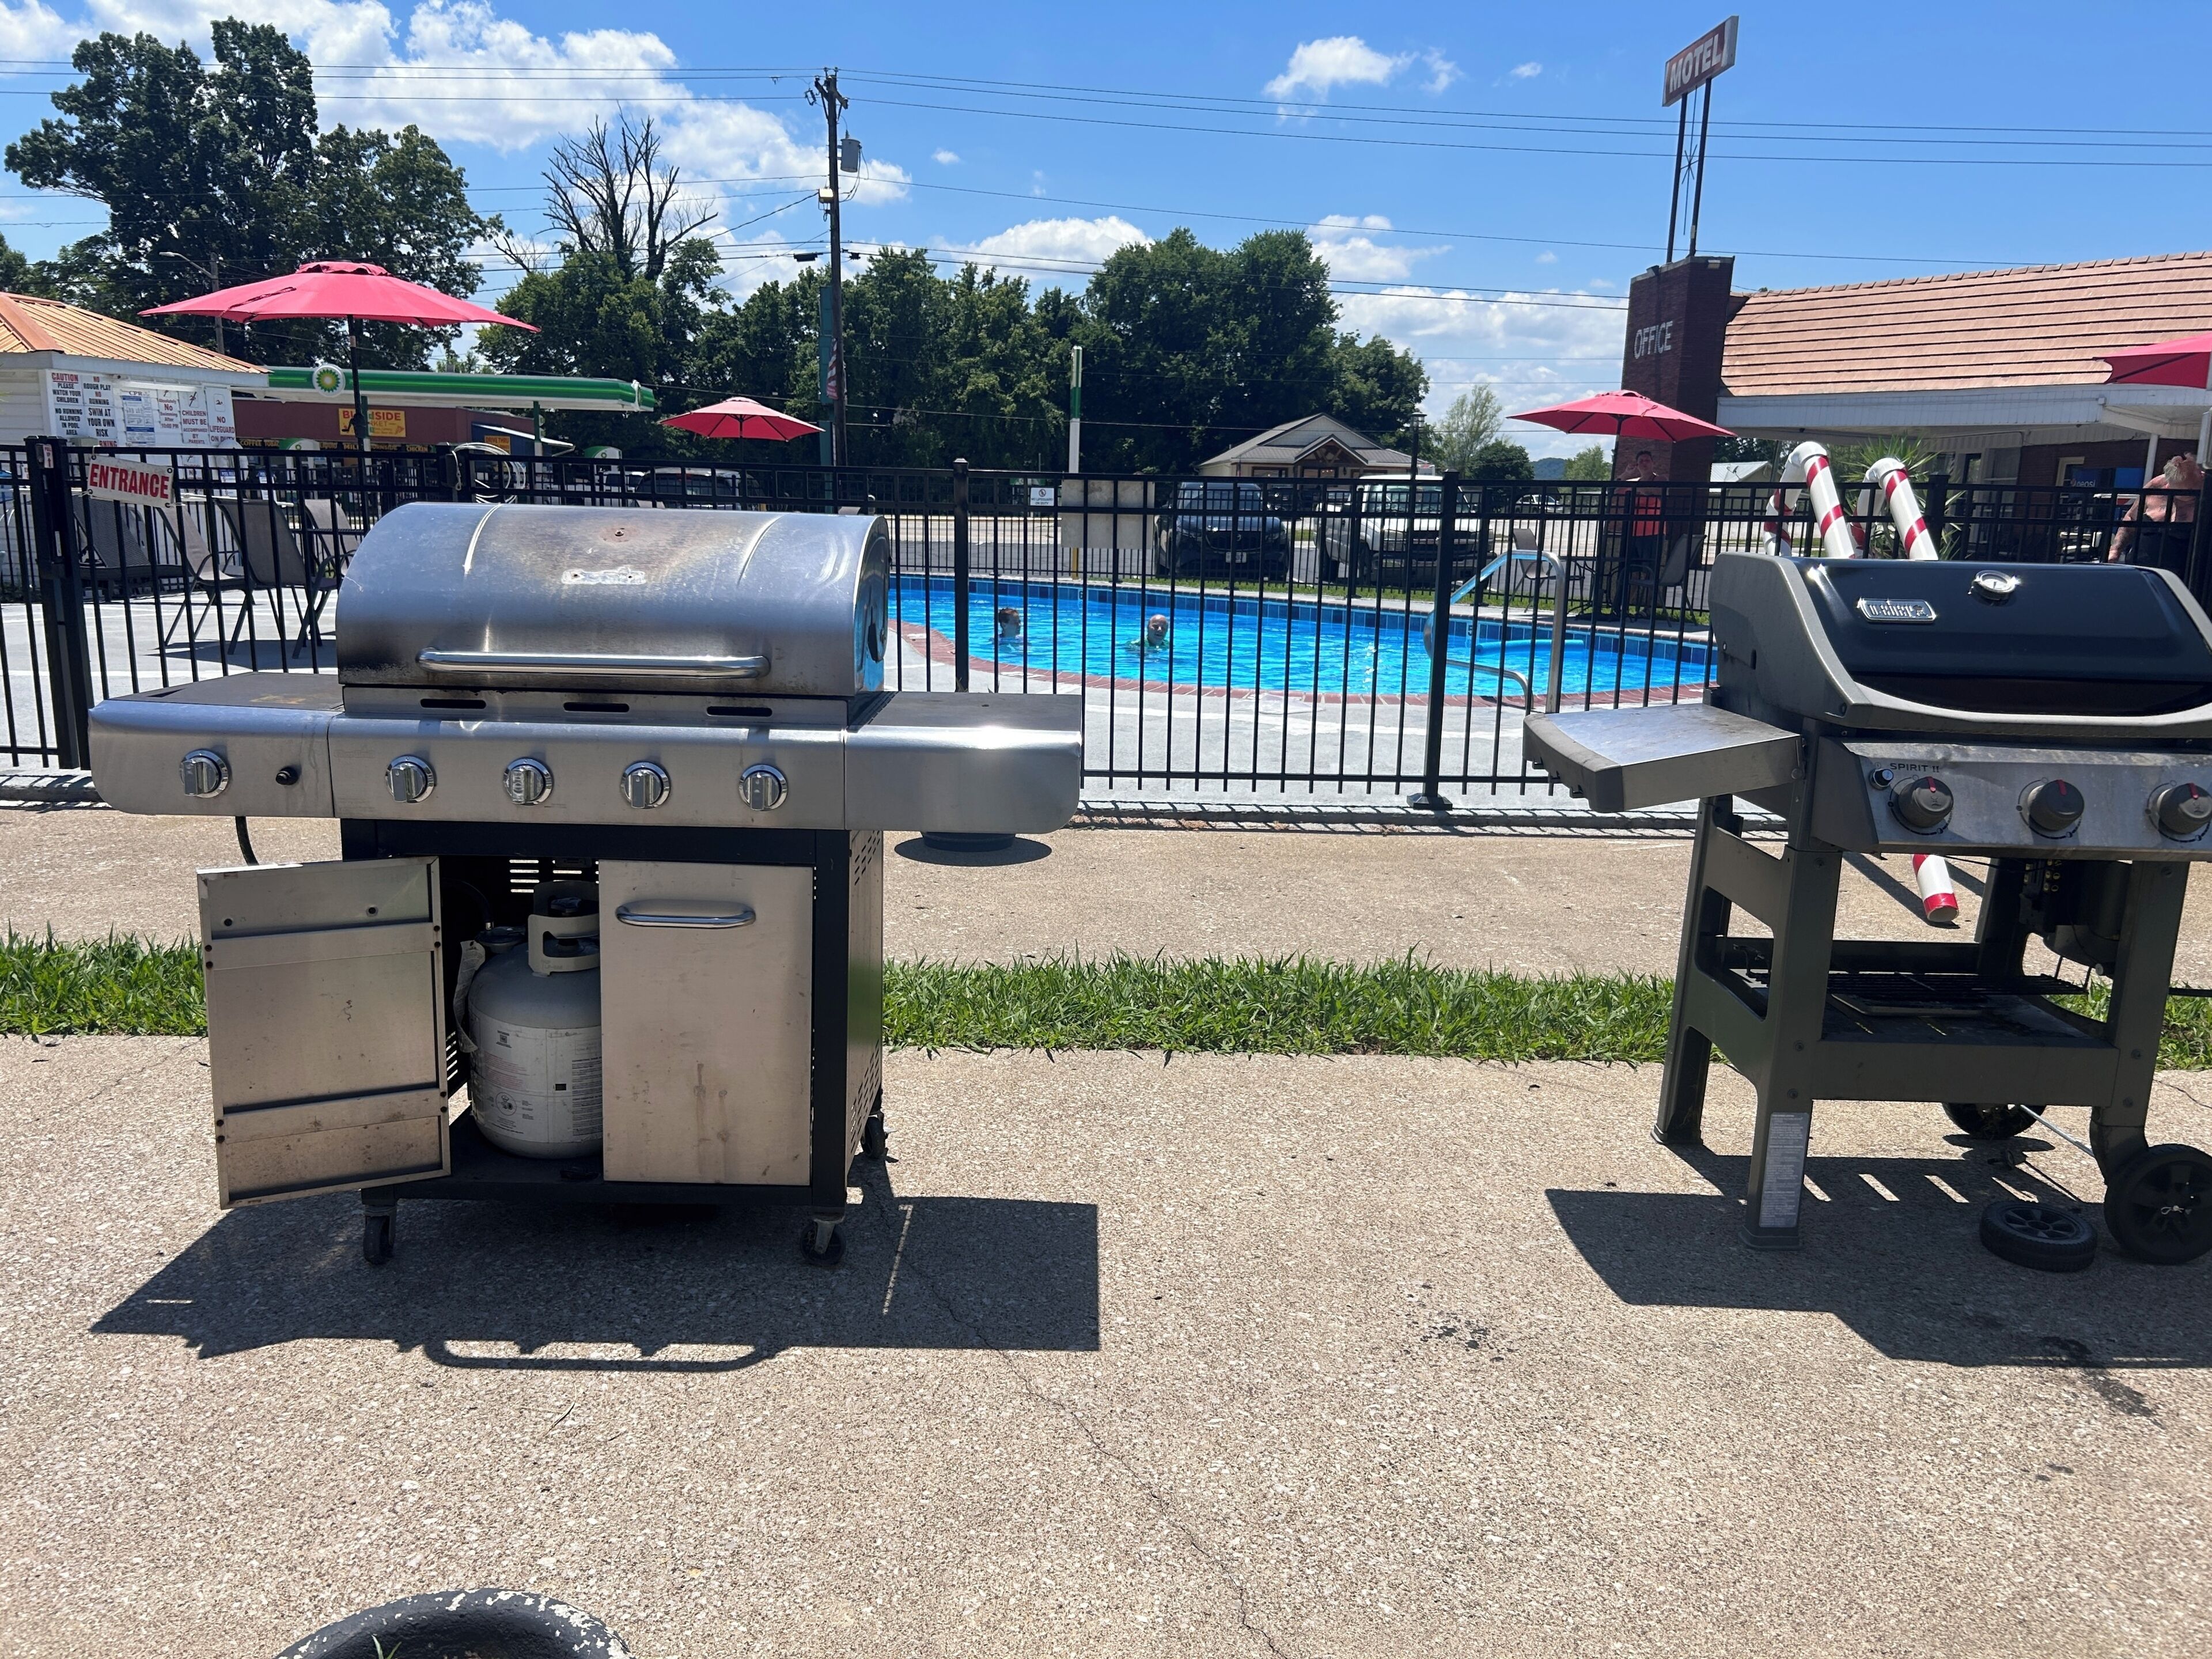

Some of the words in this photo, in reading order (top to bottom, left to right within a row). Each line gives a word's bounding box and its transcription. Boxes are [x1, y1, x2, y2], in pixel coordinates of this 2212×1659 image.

[1669, 33, 1722, 93] MOTEL
[1634, 320, 1673, 359] OFFICE
[52, 373, 79, 382] CAUTION
[88, 408, 104, 416] SWIM
[105, 408, 111, 416] AT
[88, 418, 102, 426] YOUR
[103, 419, 115, 427] OWN
[96, 429, 109, 437] RISK
[89, 463, 169, 499] ENTRANCE
[1890, 763, 1928, 772] SPIRIT
